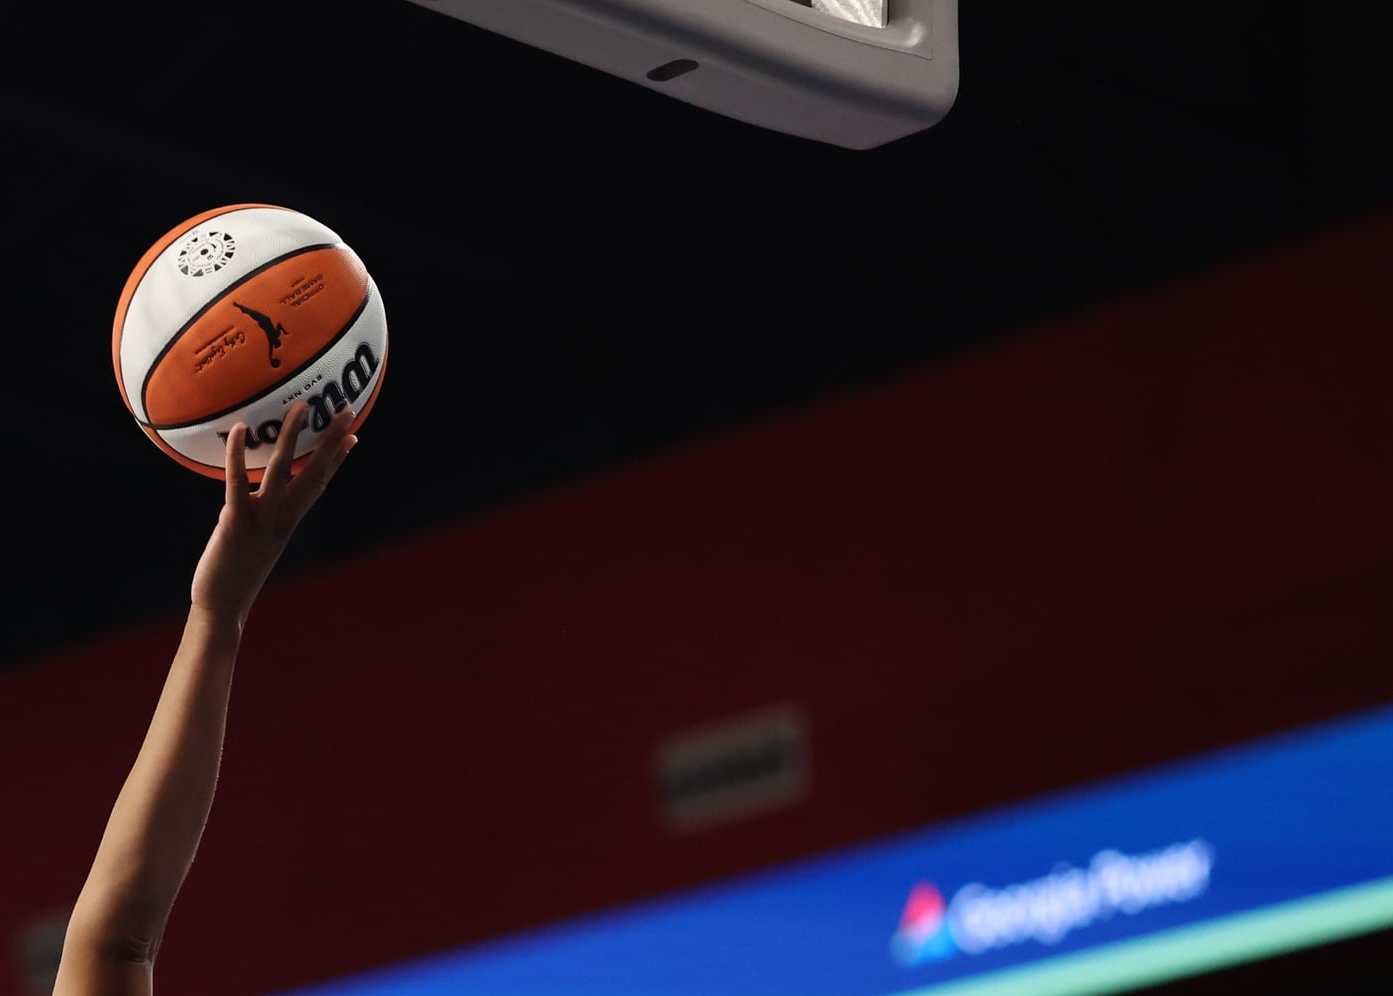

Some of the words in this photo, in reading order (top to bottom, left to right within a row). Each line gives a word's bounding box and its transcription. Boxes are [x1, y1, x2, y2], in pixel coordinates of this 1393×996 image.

[303, 374, 323, 391] EVO
[216, 341, 380, 450] Wilon
[281, 390, 302, 405] NXT
